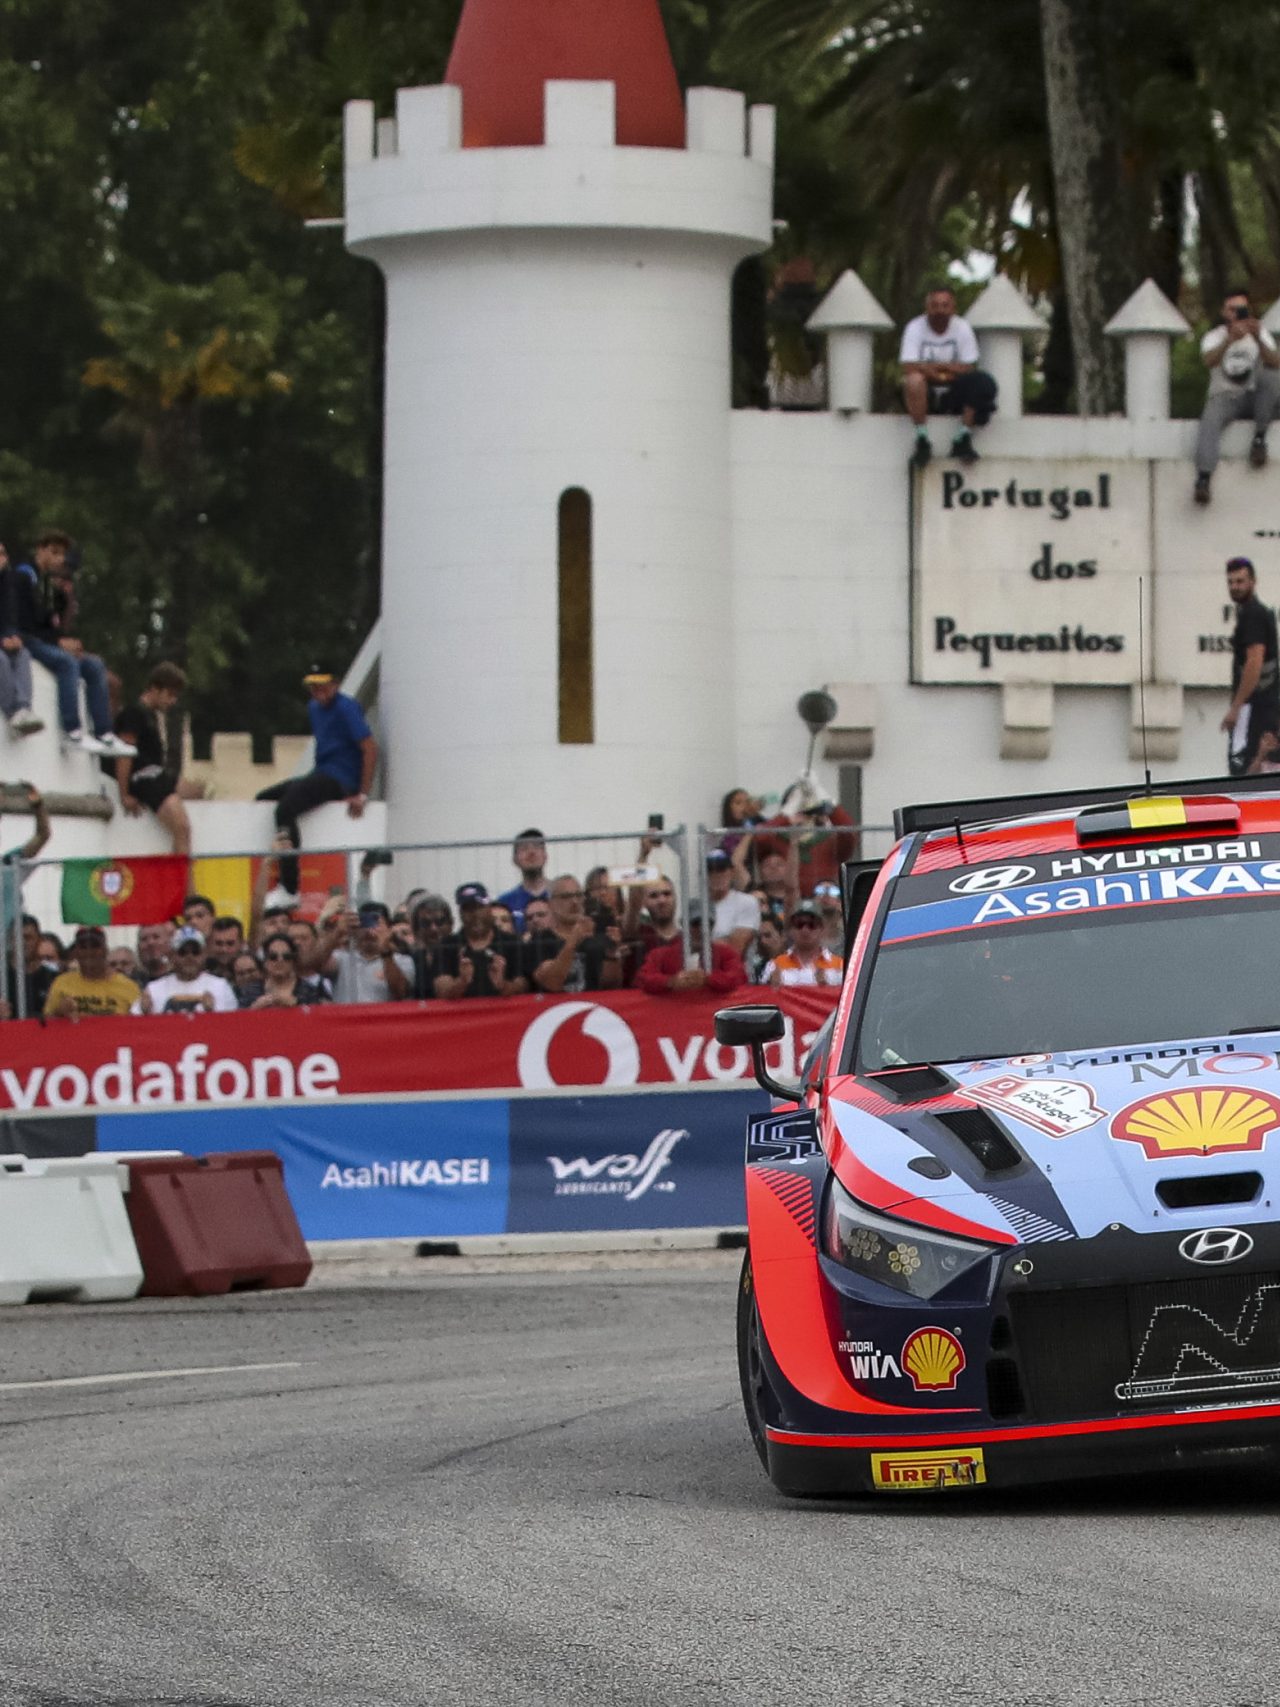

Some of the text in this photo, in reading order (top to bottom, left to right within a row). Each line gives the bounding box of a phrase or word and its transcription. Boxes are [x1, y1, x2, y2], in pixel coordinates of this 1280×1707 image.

[941, 470, 1112, 520] Portugal
[1030, 543, 1098, 581] dos
[934, 616, 1125, 668] Pequenitos
[1052, 840, 1262, 877] HYUNDAI
[2, 1042, 340, 1110] vodafone
[1026, 1043, 1235, 1078] HYUNDAI
[320, 1158, 490, 1189] AsahiKASEI
